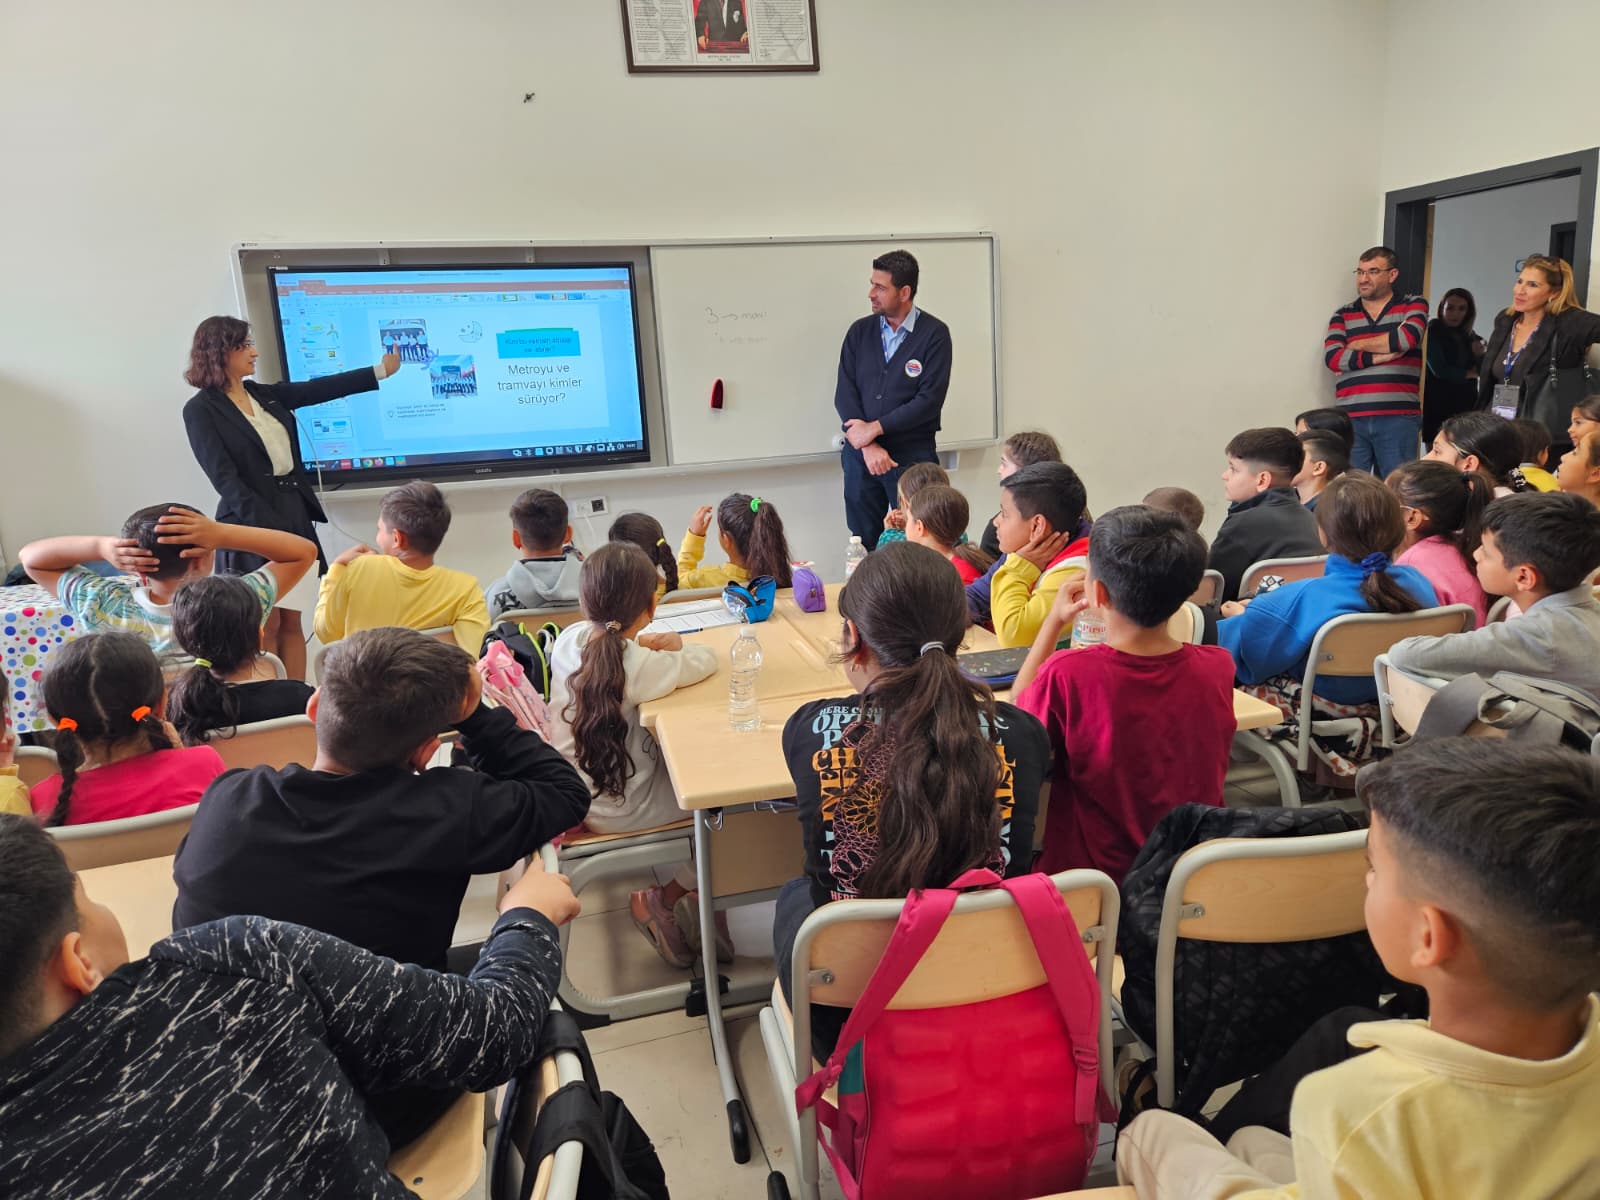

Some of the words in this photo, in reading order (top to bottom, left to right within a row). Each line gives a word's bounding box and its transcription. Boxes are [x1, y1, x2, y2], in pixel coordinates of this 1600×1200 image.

[508, 364, 553, 376] Metroyu
[557, 364, 570, 373] ve
[497, 380, 546, 391] tramvayı
[549, 376, 582, 388] kimler
[518, 392, 566, 406] sürüyor?
[820, 705, 849, 715] HERE
